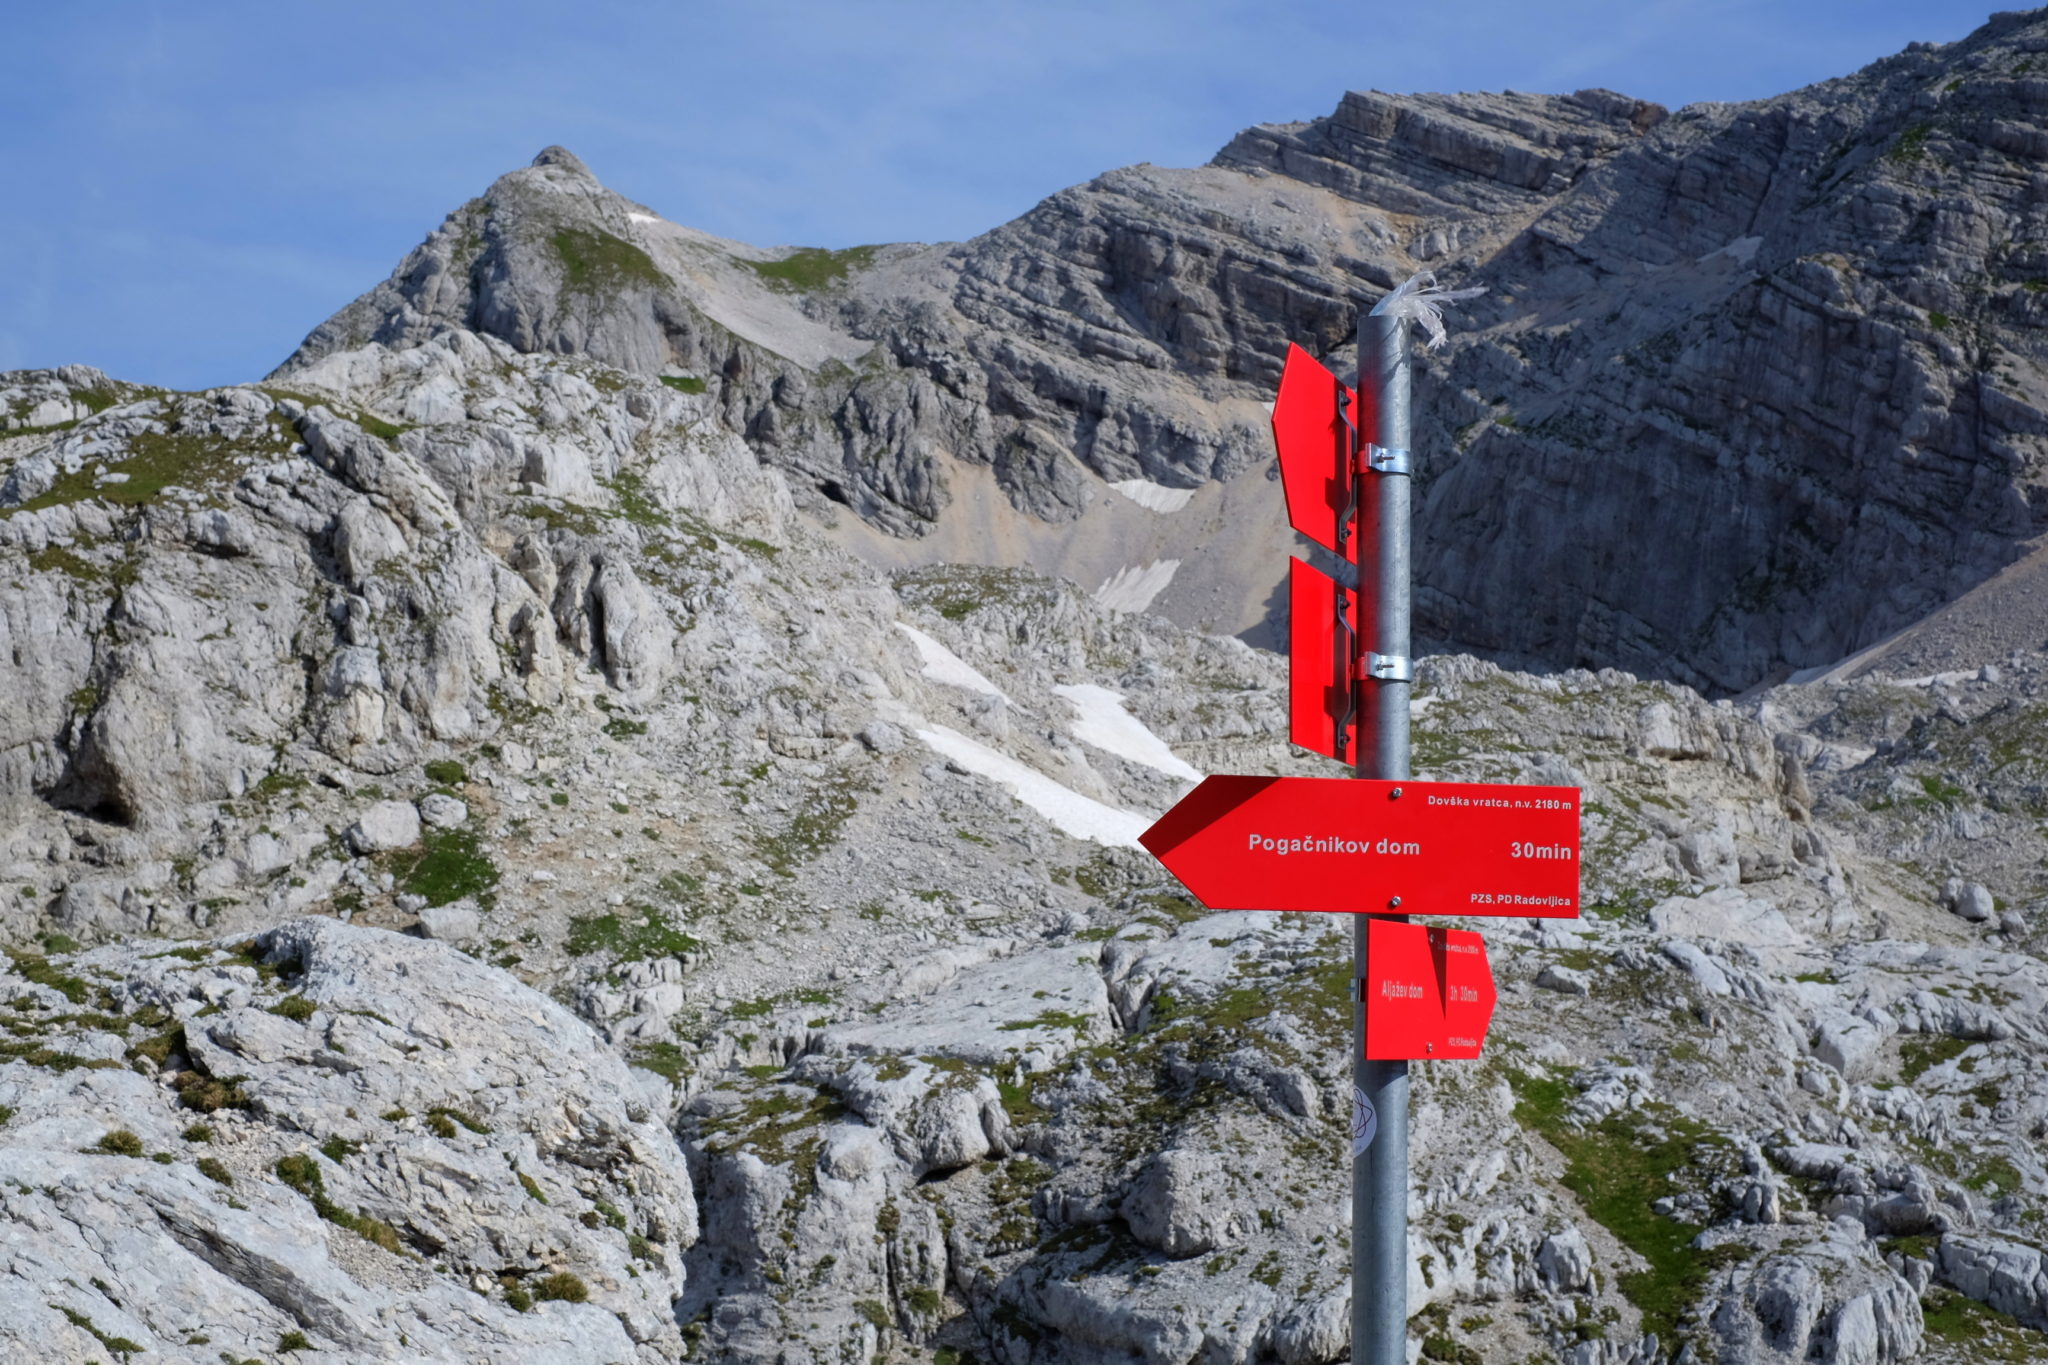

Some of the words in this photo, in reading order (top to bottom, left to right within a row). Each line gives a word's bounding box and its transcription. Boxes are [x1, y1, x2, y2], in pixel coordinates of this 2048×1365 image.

[1428, 795, 1470, 806] Dovška
[1472, 798, 1513, 809] vratca,
[1515, 800, 1533, 809] n.v.
[1535, 799, 1560, 810] 2180
[1562, 802, 1572, 810] m
[1249, 833, 1370, 856] Pogačnikov
[1376, 838, 1420, 855] dom
[1511, 841, 1572, 860] 30min
[1471, 893, 1496, 904] PZS,
[1497, 894, 1513, 904] PD
[1514, 894, 1571, 908] Radovljica
[1382, 980, 1408, 1001] Aljažev
[1408, 983, 1423, 999] dom
